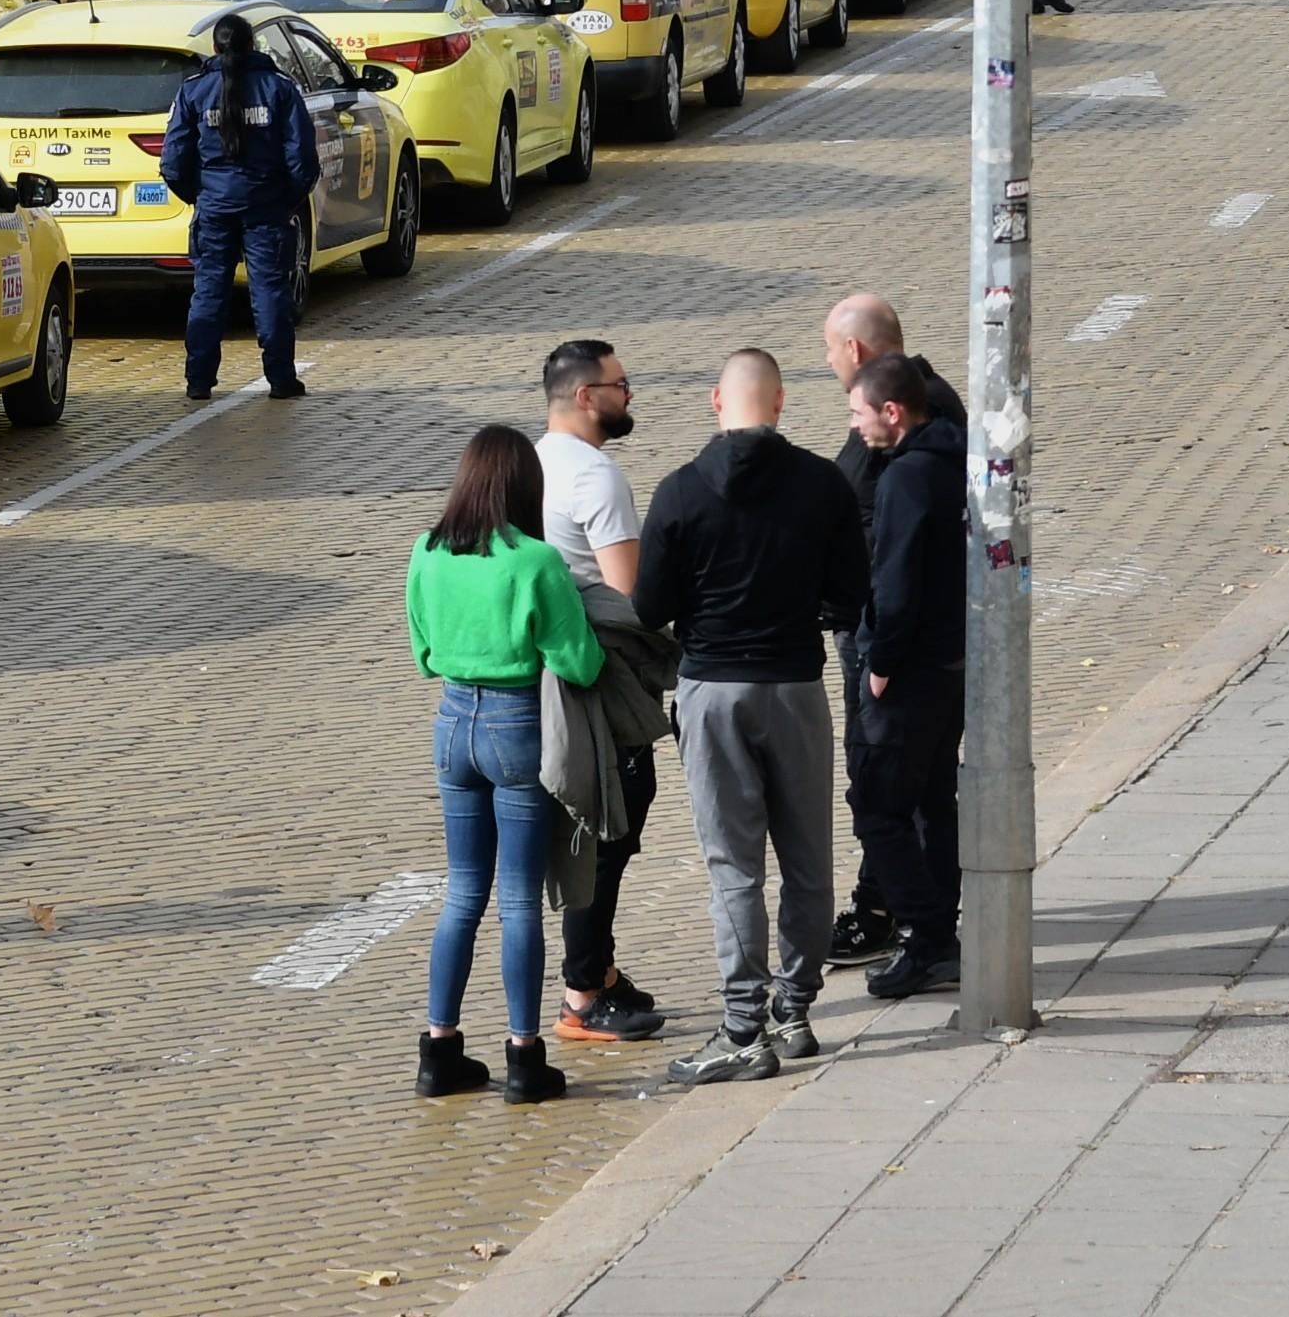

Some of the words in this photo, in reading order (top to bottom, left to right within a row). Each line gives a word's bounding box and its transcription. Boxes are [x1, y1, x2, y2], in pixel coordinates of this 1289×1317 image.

[583, 15, 608, 23] TAXI
[10, 128, 58, 139] СВАЛИ
[64, 128, 111, 139] TaxiMe
[47, 144, 69, 153] KIA
[52, 191, 86, 209] 590
[137, 192, 164, 202] 243007
